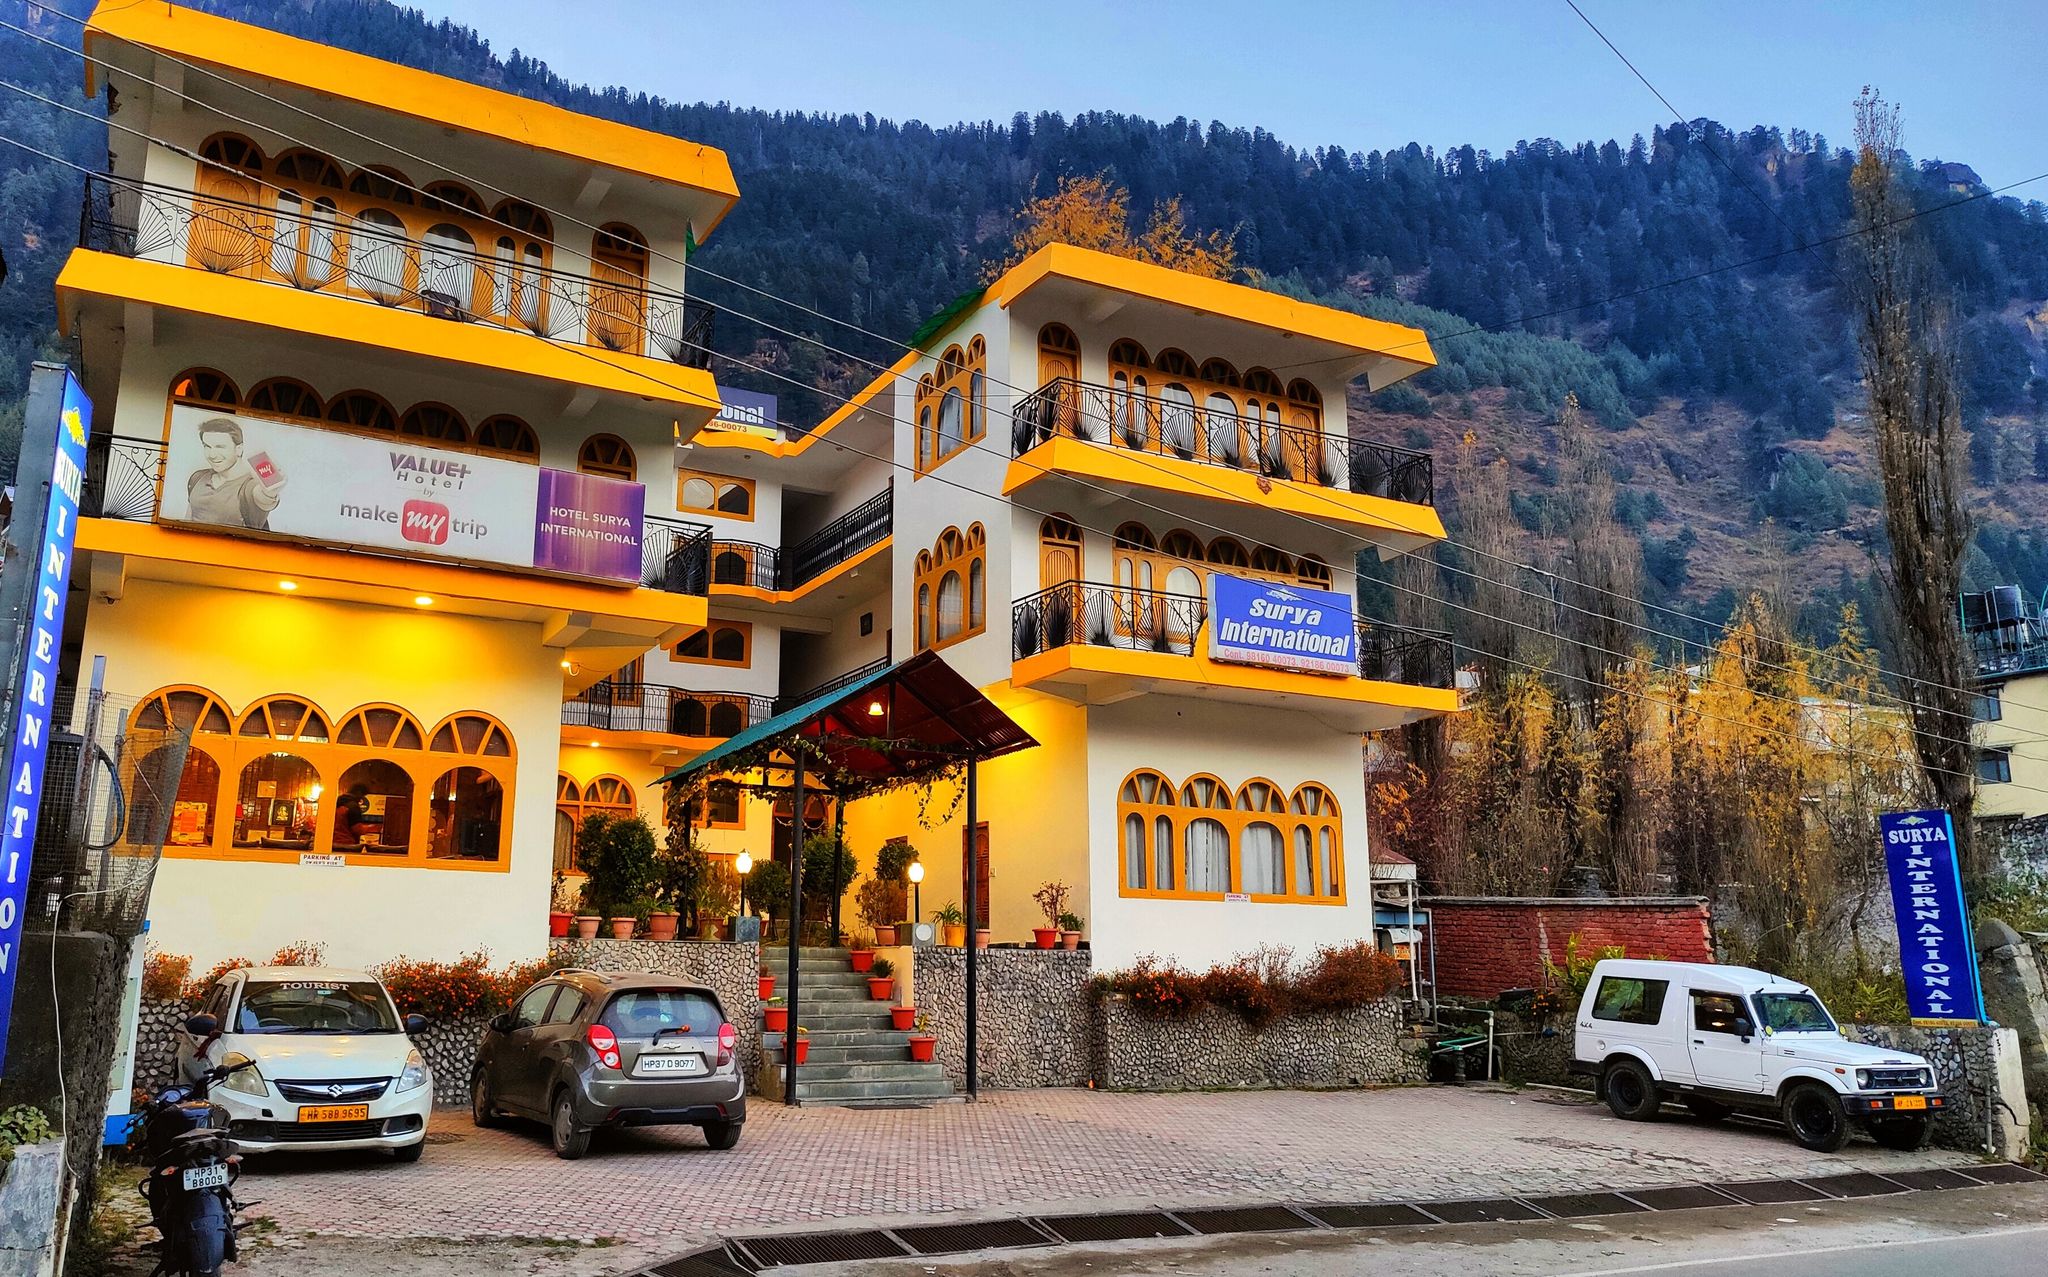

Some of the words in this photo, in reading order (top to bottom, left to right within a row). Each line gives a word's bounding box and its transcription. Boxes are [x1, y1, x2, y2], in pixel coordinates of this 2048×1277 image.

[389, 452, 471, 479] VALUE+
[54, 447, 82, 508] SURYA
[396, 471, 463, 490] Hotel
[423, 488, 434, 497] by
[340, 503, 399, 523] make
[406, 510, 446, 542] my
[452, 518, 488, 540] trip
[550, 506, 589, 521] HOTEL
[592, 513, 631, 528] SURYA
[541, 522, 638, 546] INTERNATIONAL
[1249, 598, 1322, 626] Surya
[1220, 618, 1350, 657] International
[1246, 651, 1269, 662] 98160
[1327, 663, 1350, 673] 00073
[1888, 827, 1947, 844] SURYA
[1905, 845, 1954, 1014] INTERNATIONAL
[280, 982, 349, 991] TOURIST
[644, 1060, 665, 1068] HP37
[307, 1108, 319, 1120] HR
[342, 1108, 366, 1118] 9695
[192, 1175, 223, 1188] B8009
[194, 1166, 218, 1178] HP31
